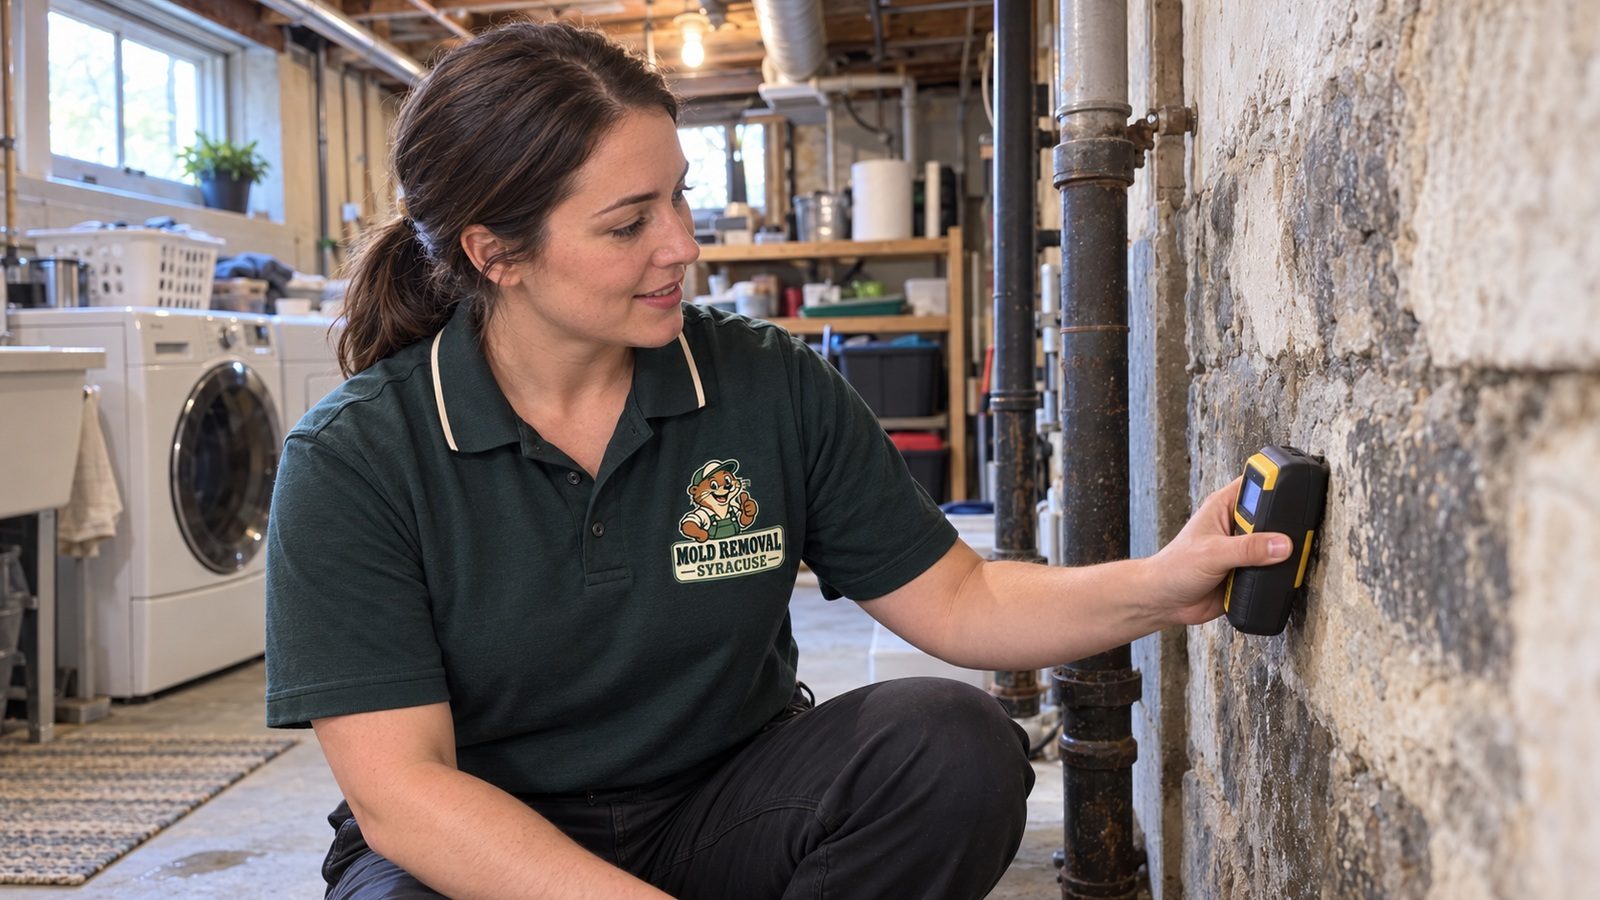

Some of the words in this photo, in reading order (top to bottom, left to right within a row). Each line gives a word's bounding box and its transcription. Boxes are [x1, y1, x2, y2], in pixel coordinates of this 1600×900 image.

[676, 543, 716, 566] MOLD
[719, 532, 781, 559] REMOVAL
[697, 555, 767, 577] SYRACUSE
